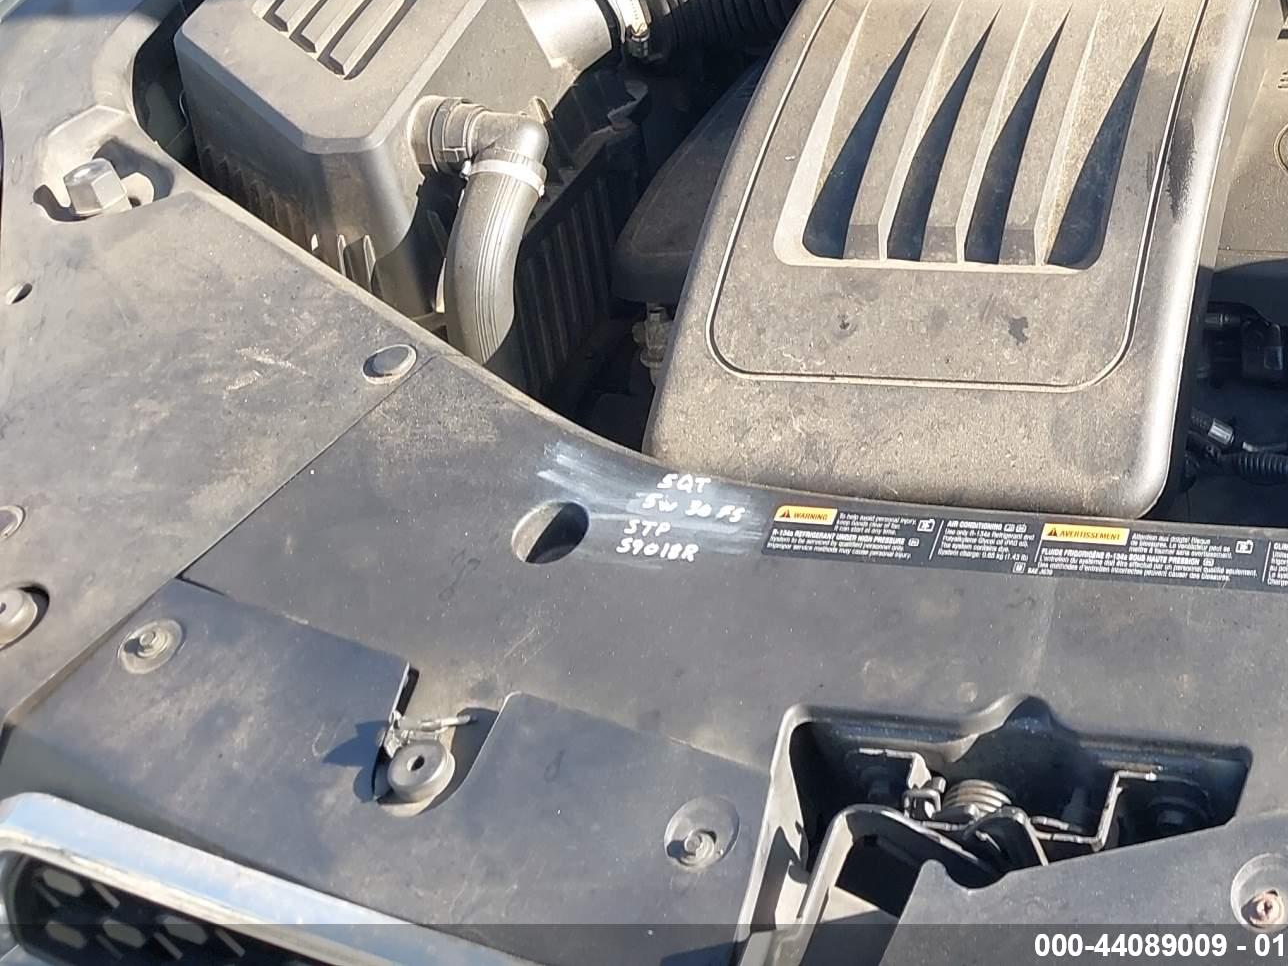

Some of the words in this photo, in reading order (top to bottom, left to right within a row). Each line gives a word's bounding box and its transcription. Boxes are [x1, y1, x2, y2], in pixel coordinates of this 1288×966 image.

[793, 512, 828, 520] WARNING
[959, 521, 1002, 530] CONDITIONING
[1060, 530, 1120, 540] AVERTISSEMENT
